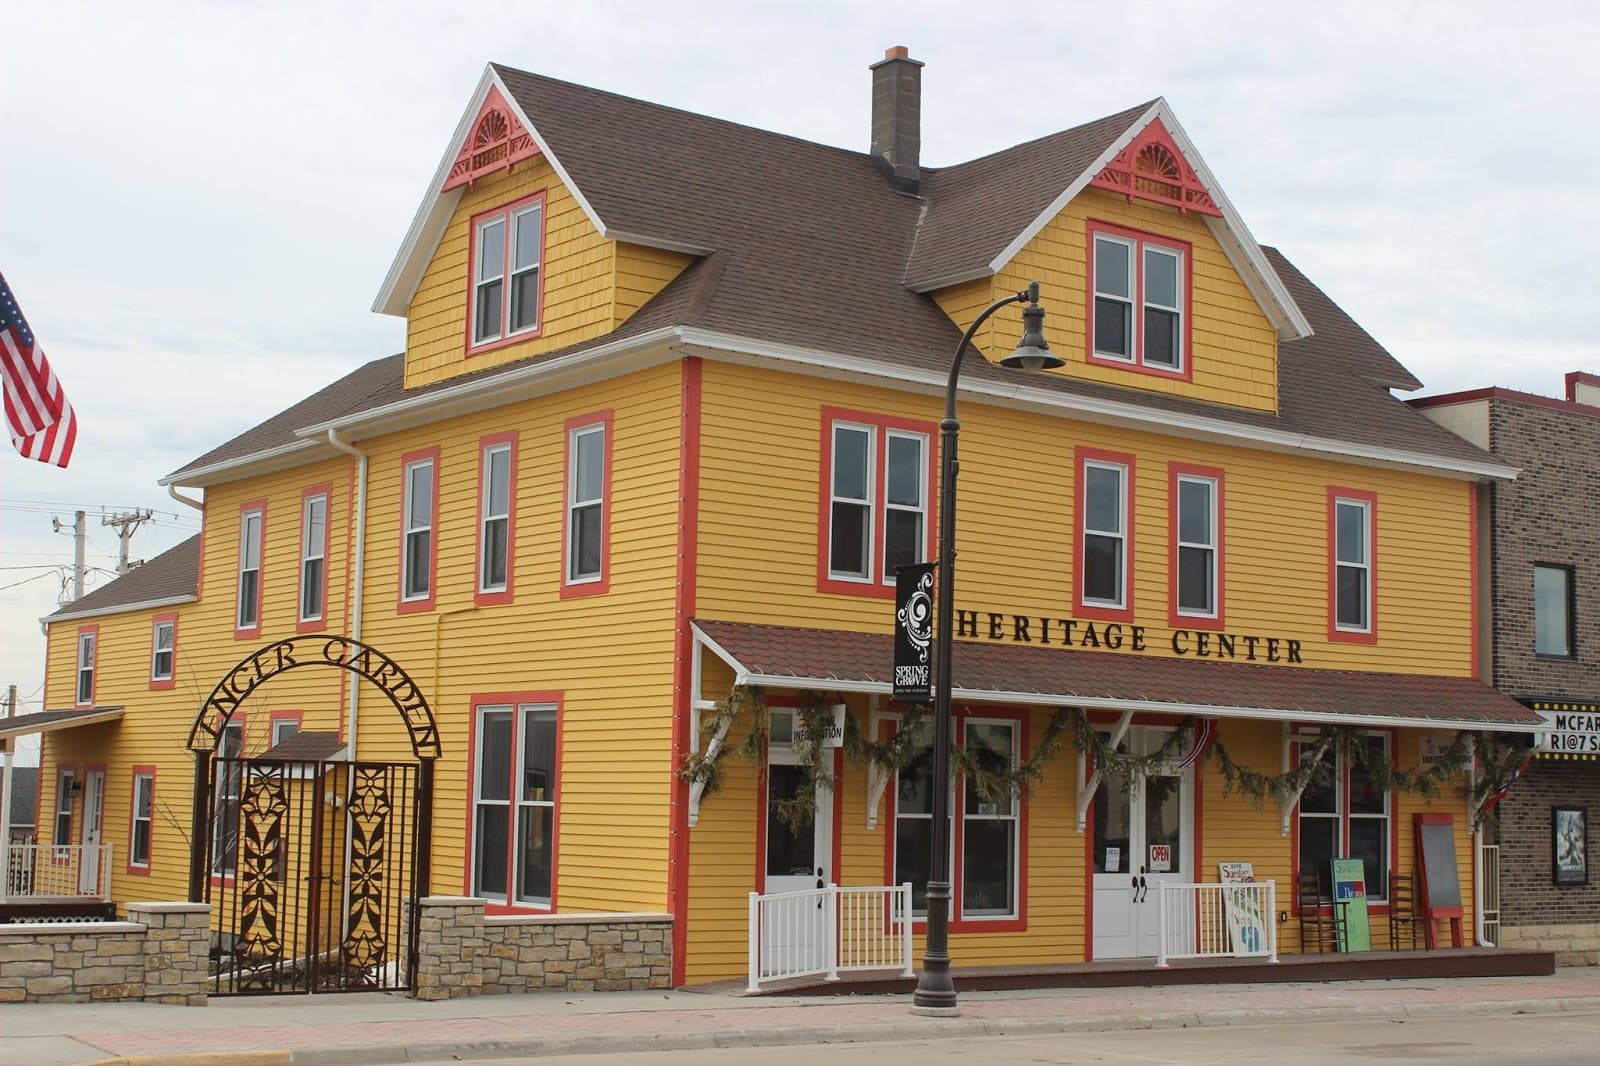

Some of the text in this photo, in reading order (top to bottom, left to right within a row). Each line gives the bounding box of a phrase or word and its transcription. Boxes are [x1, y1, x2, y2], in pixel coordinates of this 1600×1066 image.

[957, 609, 1303, 664] HERITAGE CENTER
[895, 665, 929, 677] SPRING
[322, 638, 437, 748] GARDEN
[1152, 846, 1169, 861] OPEN
